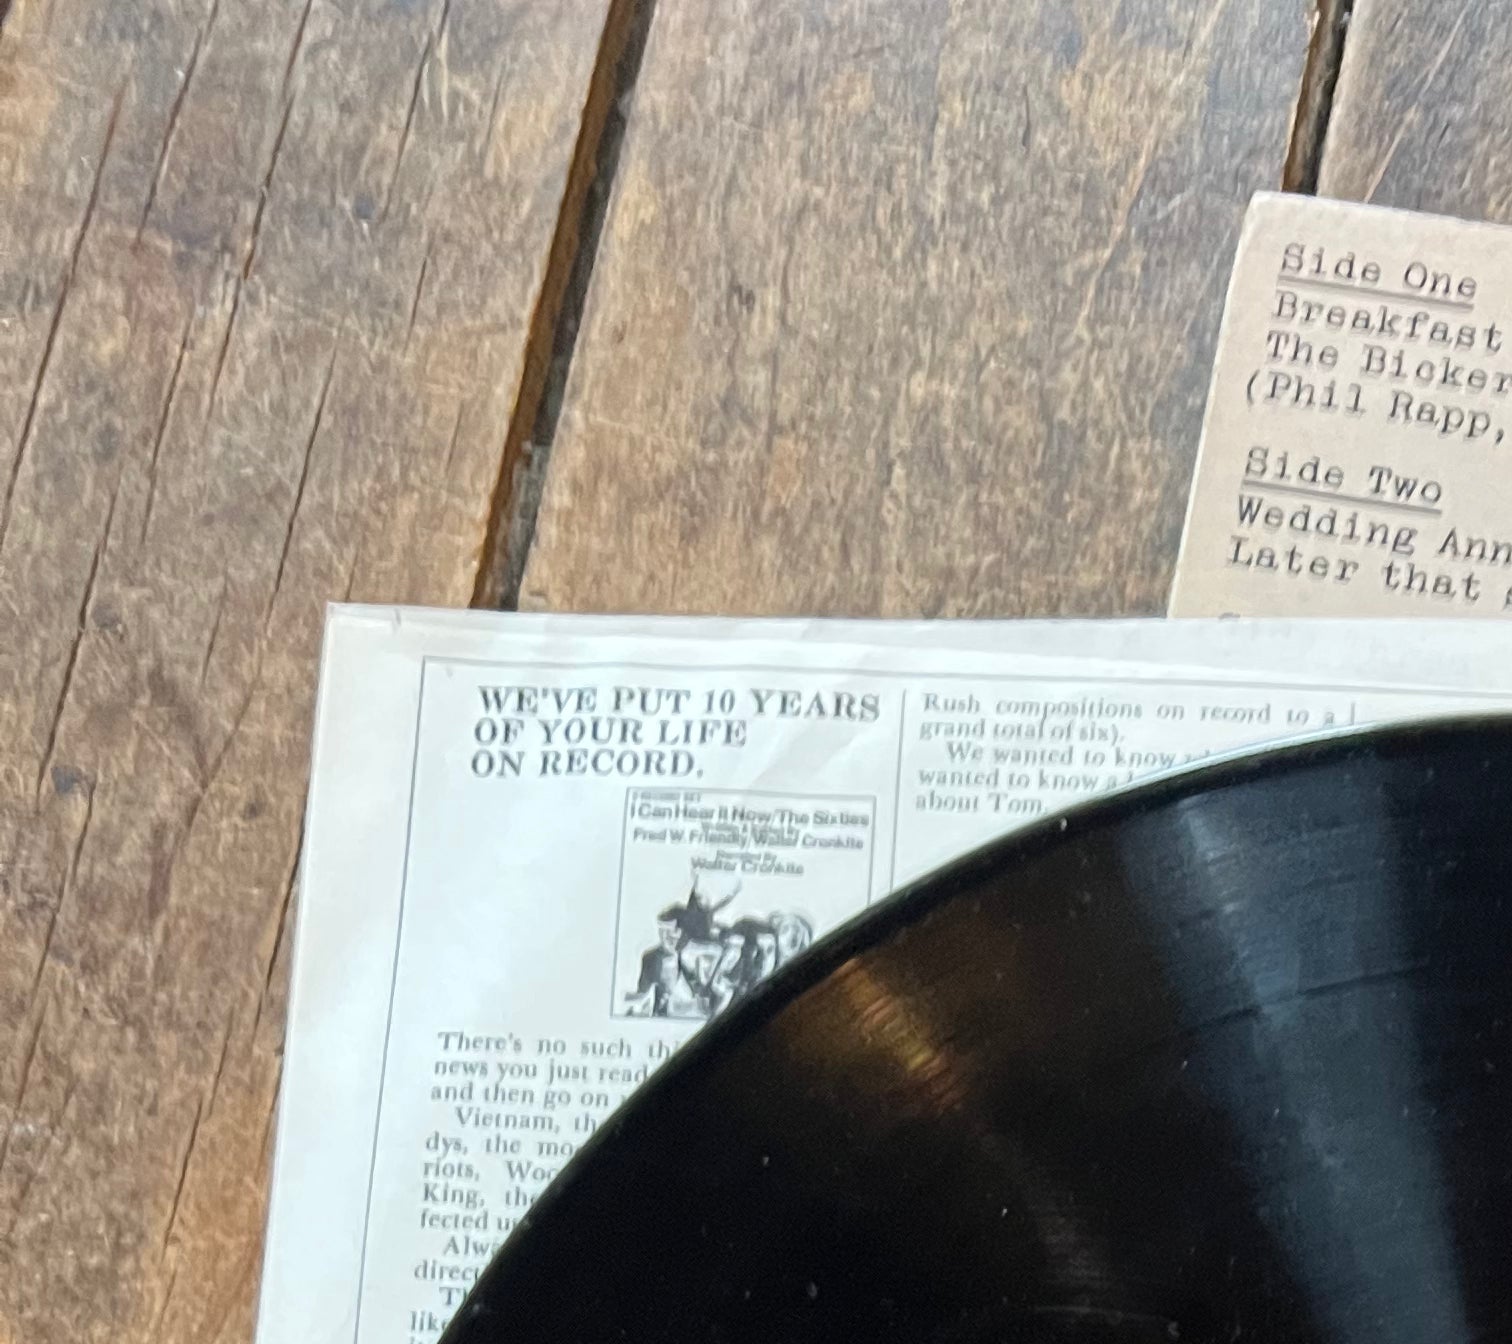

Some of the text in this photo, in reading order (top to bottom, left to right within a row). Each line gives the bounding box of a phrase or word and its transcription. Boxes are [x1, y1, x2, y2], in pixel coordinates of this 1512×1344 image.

[1282, 244, 1476, 298] Side One
[1273, 291, 1501, 353] Breakfast
[1267, 330, 1338, 368] The
[1247, 372, 1365, 414] (Phil
[1388, 391, 1504, 445] Rapp,
[1245, 447, 1441, 503] Side Two
[1239, 494, 1417, 557] Wedding
[1229, 536, 1359, 581] Later
[1384, 561, 1479, 601] that
[479, 686, 879, 720] WE'VE PUT 10 YEARS
[923, 693, 1335, 725] Rush compositions on record to a
[475, 718, 746, 746] OF YOUR LIFE
[471, 749, 703, 777] ON RECORD.
[438, 1032, 632, 1057] There's no such
[435, 1059, 648, 1084] news you just read
[431, 1083, 609, 1110] and then go on
